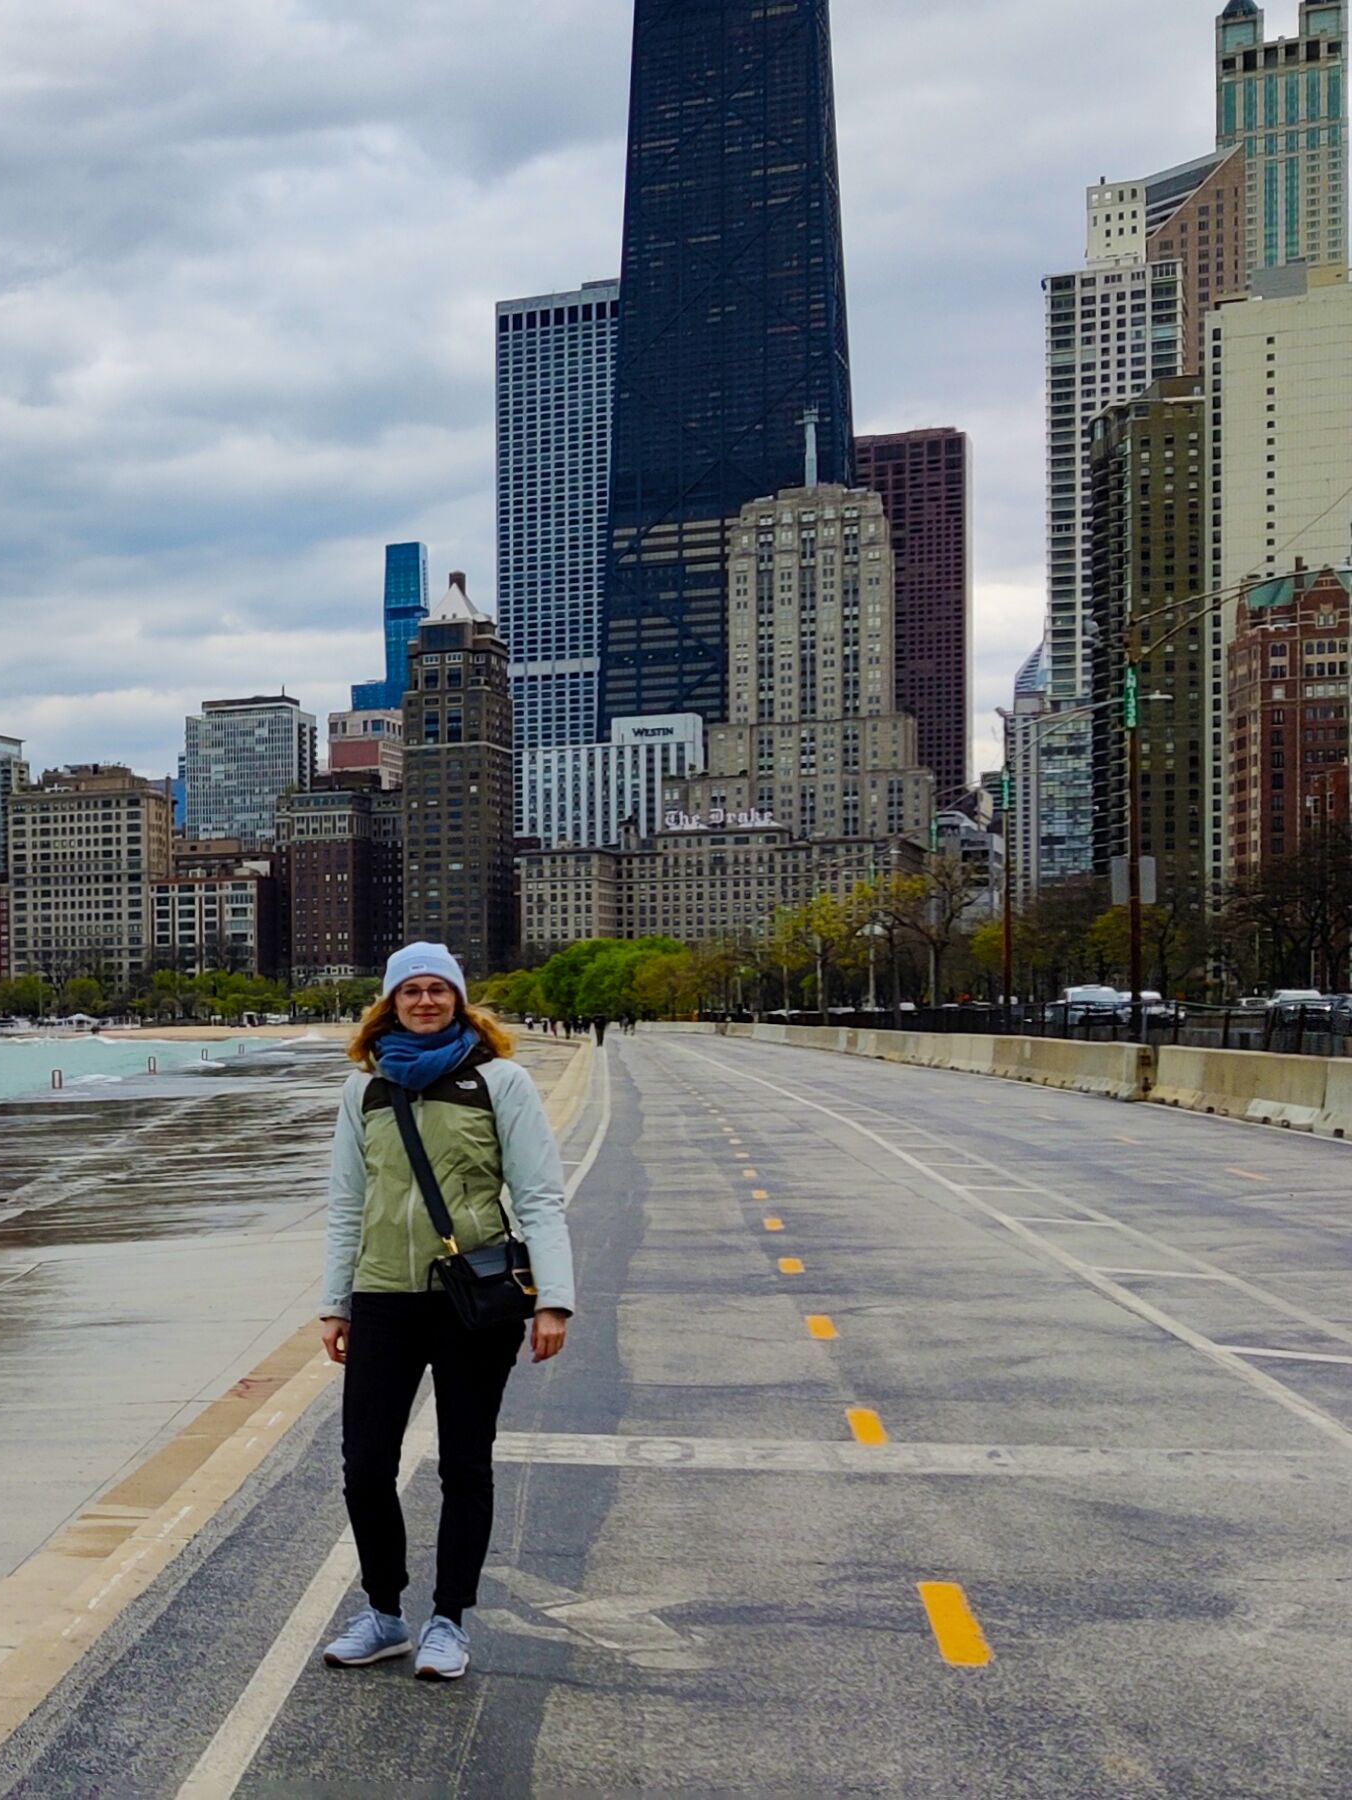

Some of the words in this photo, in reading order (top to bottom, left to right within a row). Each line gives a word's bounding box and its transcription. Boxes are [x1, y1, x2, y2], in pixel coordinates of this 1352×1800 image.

[632, 727, 673, 737] WESTIN
[665, 810, 701, 827] The
[709, 808, 773, 824] Drake
